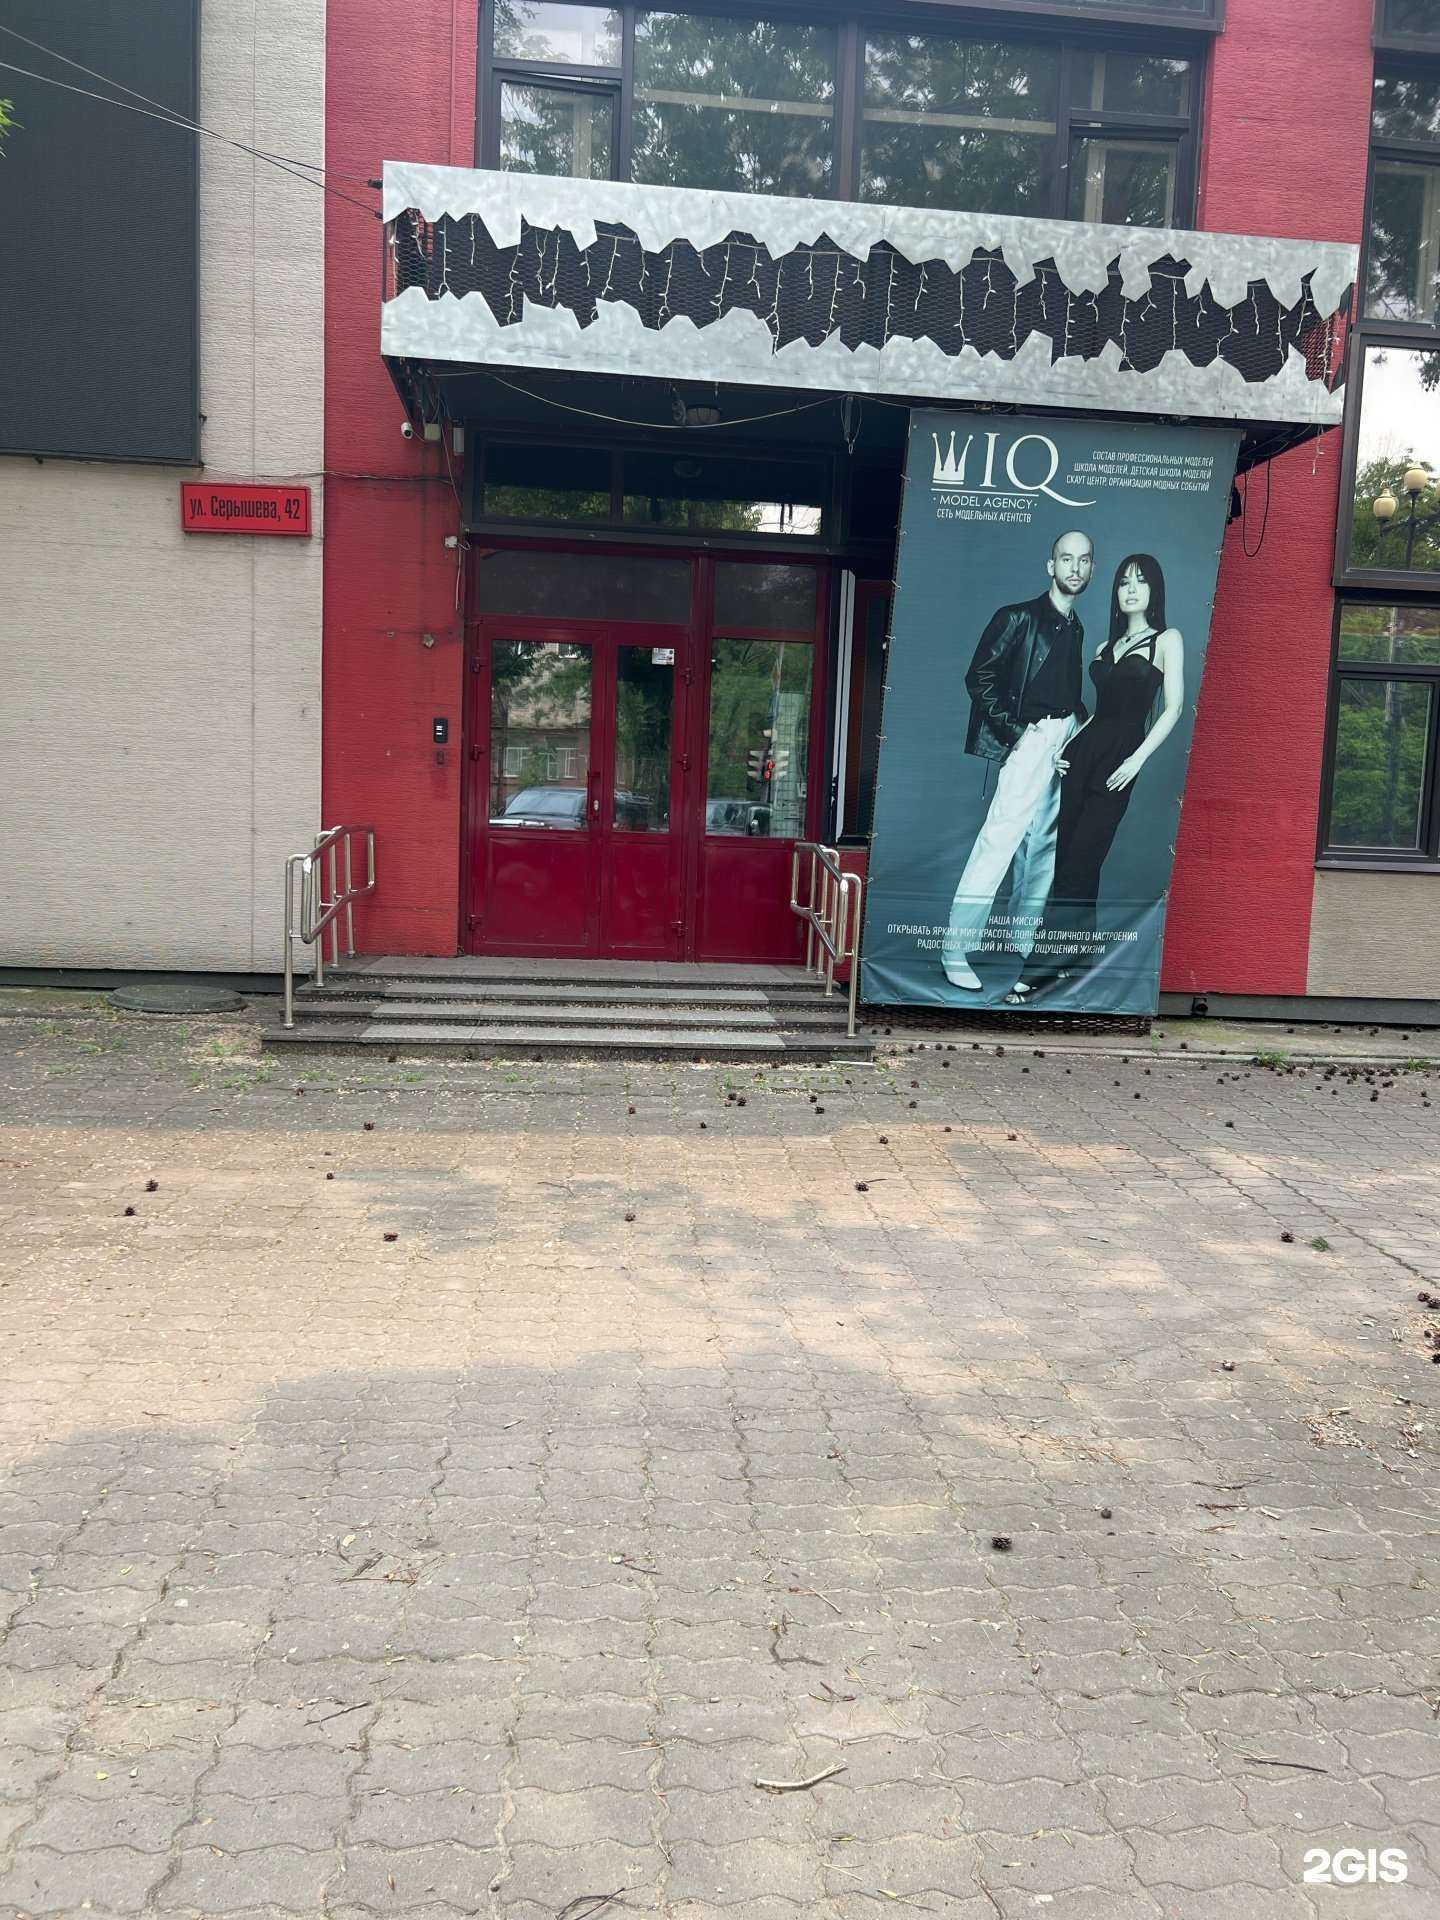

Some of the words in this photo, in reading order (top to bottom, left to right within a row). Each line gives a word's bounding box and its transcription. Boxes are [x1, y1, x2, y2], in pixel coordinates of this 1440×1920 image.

[1092, 450, 1116, 461] СОСТАВ
[1117, 452, 1183, 466] ПРОФЕССИОНАЛЬНЫХ
[1185, 456, 1214, 467] МОДЕЛЕЙ
[980, 432, 1097, 507] IQ
[1074, 463, 1097, 472] ШКОЛА
[1130, 465, 1158, 476] ДЕТСКАЯ
[1159, 466, 1182, 478] ШКОЛА
[1182, 468, 1212, 480] МОДЕЛЕЙ
[1066, 474, 1086, 485] СКАУТ
[1108, 477, 1152, 489] ОРГАНИЗАЦИЯ
[1152, 480, 1180, 491] МОДНЫХ
[1180, 481, 1210, 492] СОБЫТИЙ
[190, 498, 207, 519] ул.
[210, 495, 281, 522] Серышева,
[284, 498, 301, 520] 42
[939, 494, 981, 507] MODEL
[983, 497, 1033, 510] AGENCY
[936, 508, 954, 519] СЕТЬ
[954, 509, 998, 521] МОДЕЛЬНЫХ
[998, 511, 1033, 523] АГЕНТСТВ
[988, 915, 1010, 925] НАША
[1012, 915, 1044, 926] МИССИЯ
[887, 923, 931, 936] ОТКРЫВАТЬ
[1048, 930, 1090, 941] ОТЛИЧНОГО
[1092, 931, 1138, 942] НАСТРОЕНИЯ
[996, 942, 1002, 951] И
[1004, 942, 1034, 953] НОВОГО
[1079, 944, 1106, 954] ЖИЗНИ
